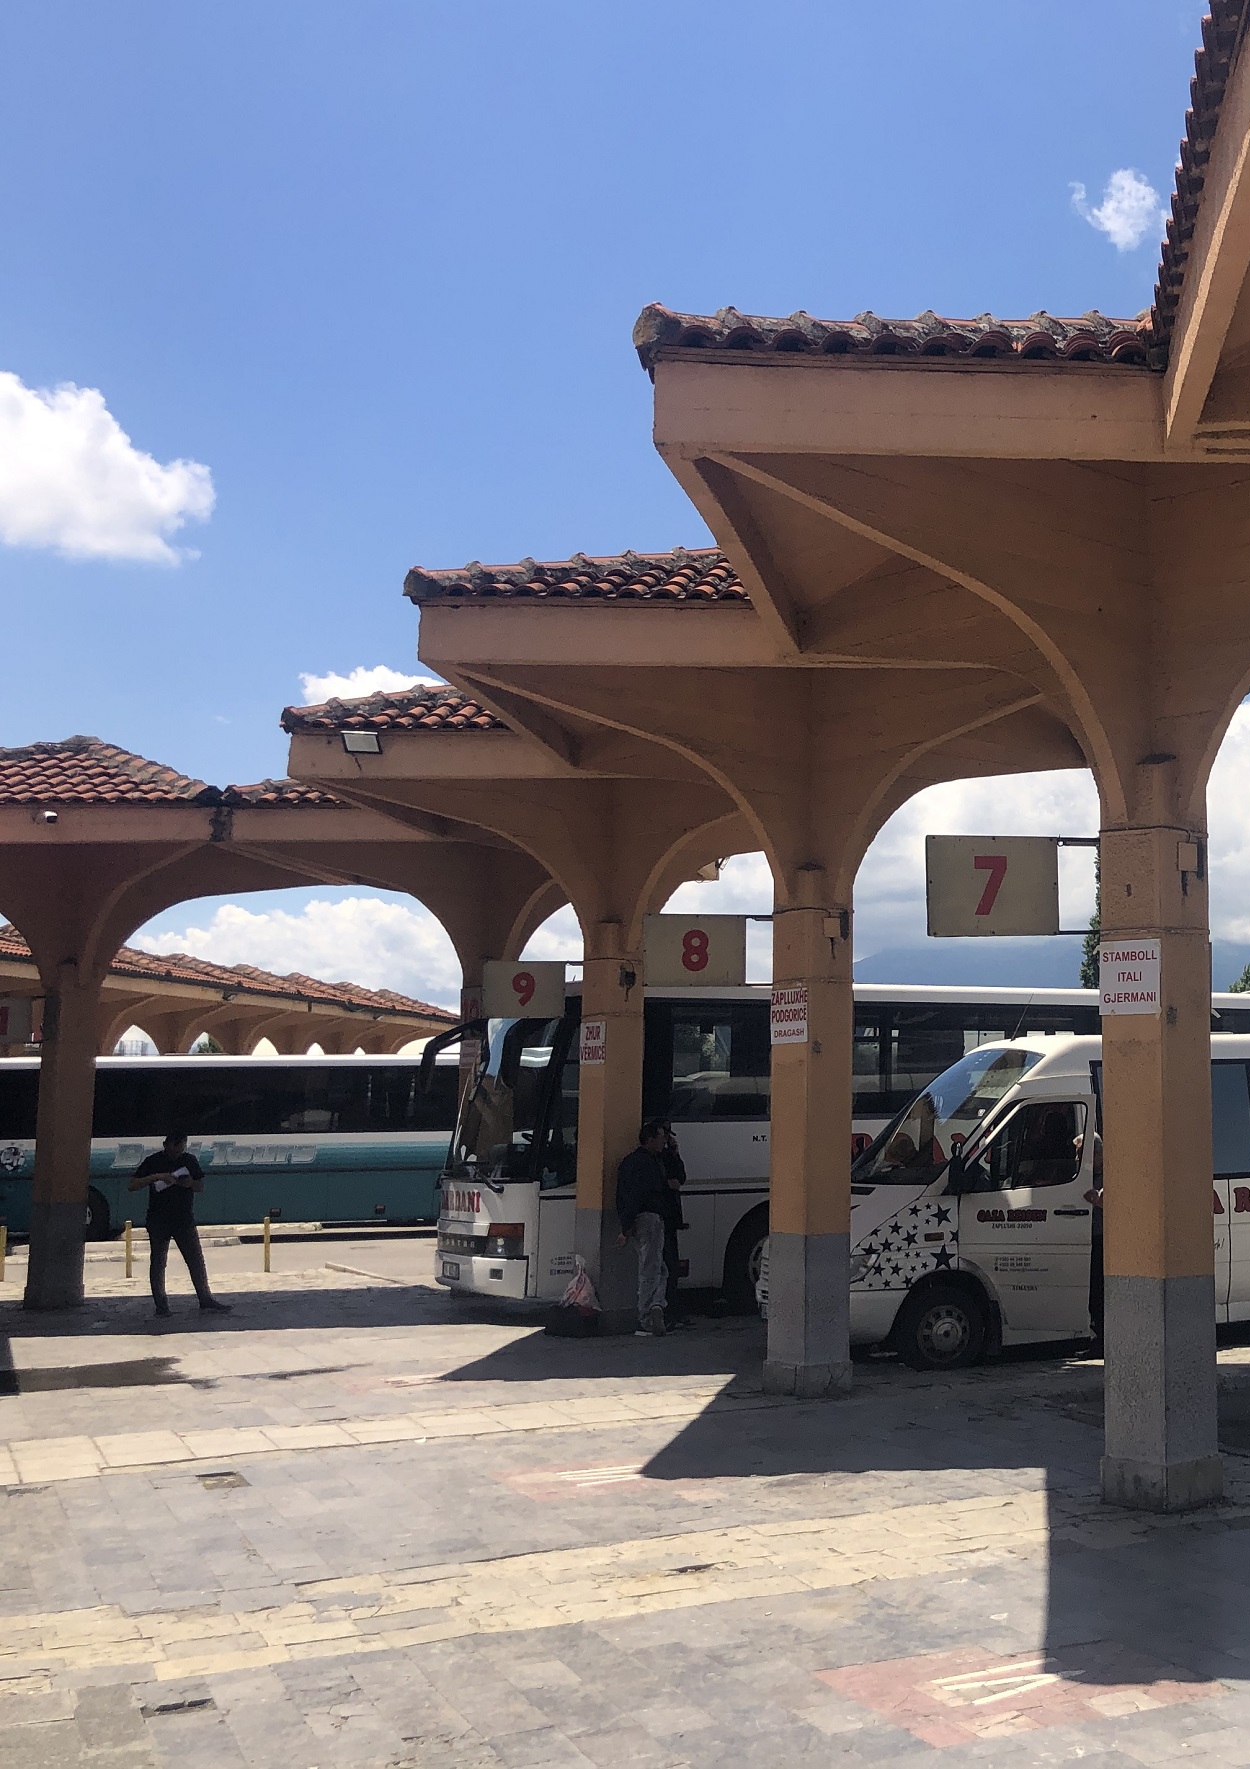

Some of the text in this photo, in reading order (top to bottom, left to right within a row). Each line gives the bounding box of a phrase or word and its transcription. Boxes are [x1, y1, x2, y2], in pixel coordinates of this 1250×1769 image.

[974, 855, 1008, 916] 7
[682, 929, 709, 972] 8
[1102, 949, 1158, 963] STAMBOLL
[1117, 971, 1142, 982] ITALI
[512, 971, 536, 1007] 9
[1103, 991, 1157, 1004] GJERMANI
[774, 1027, 805, 1038] DRAGASH
